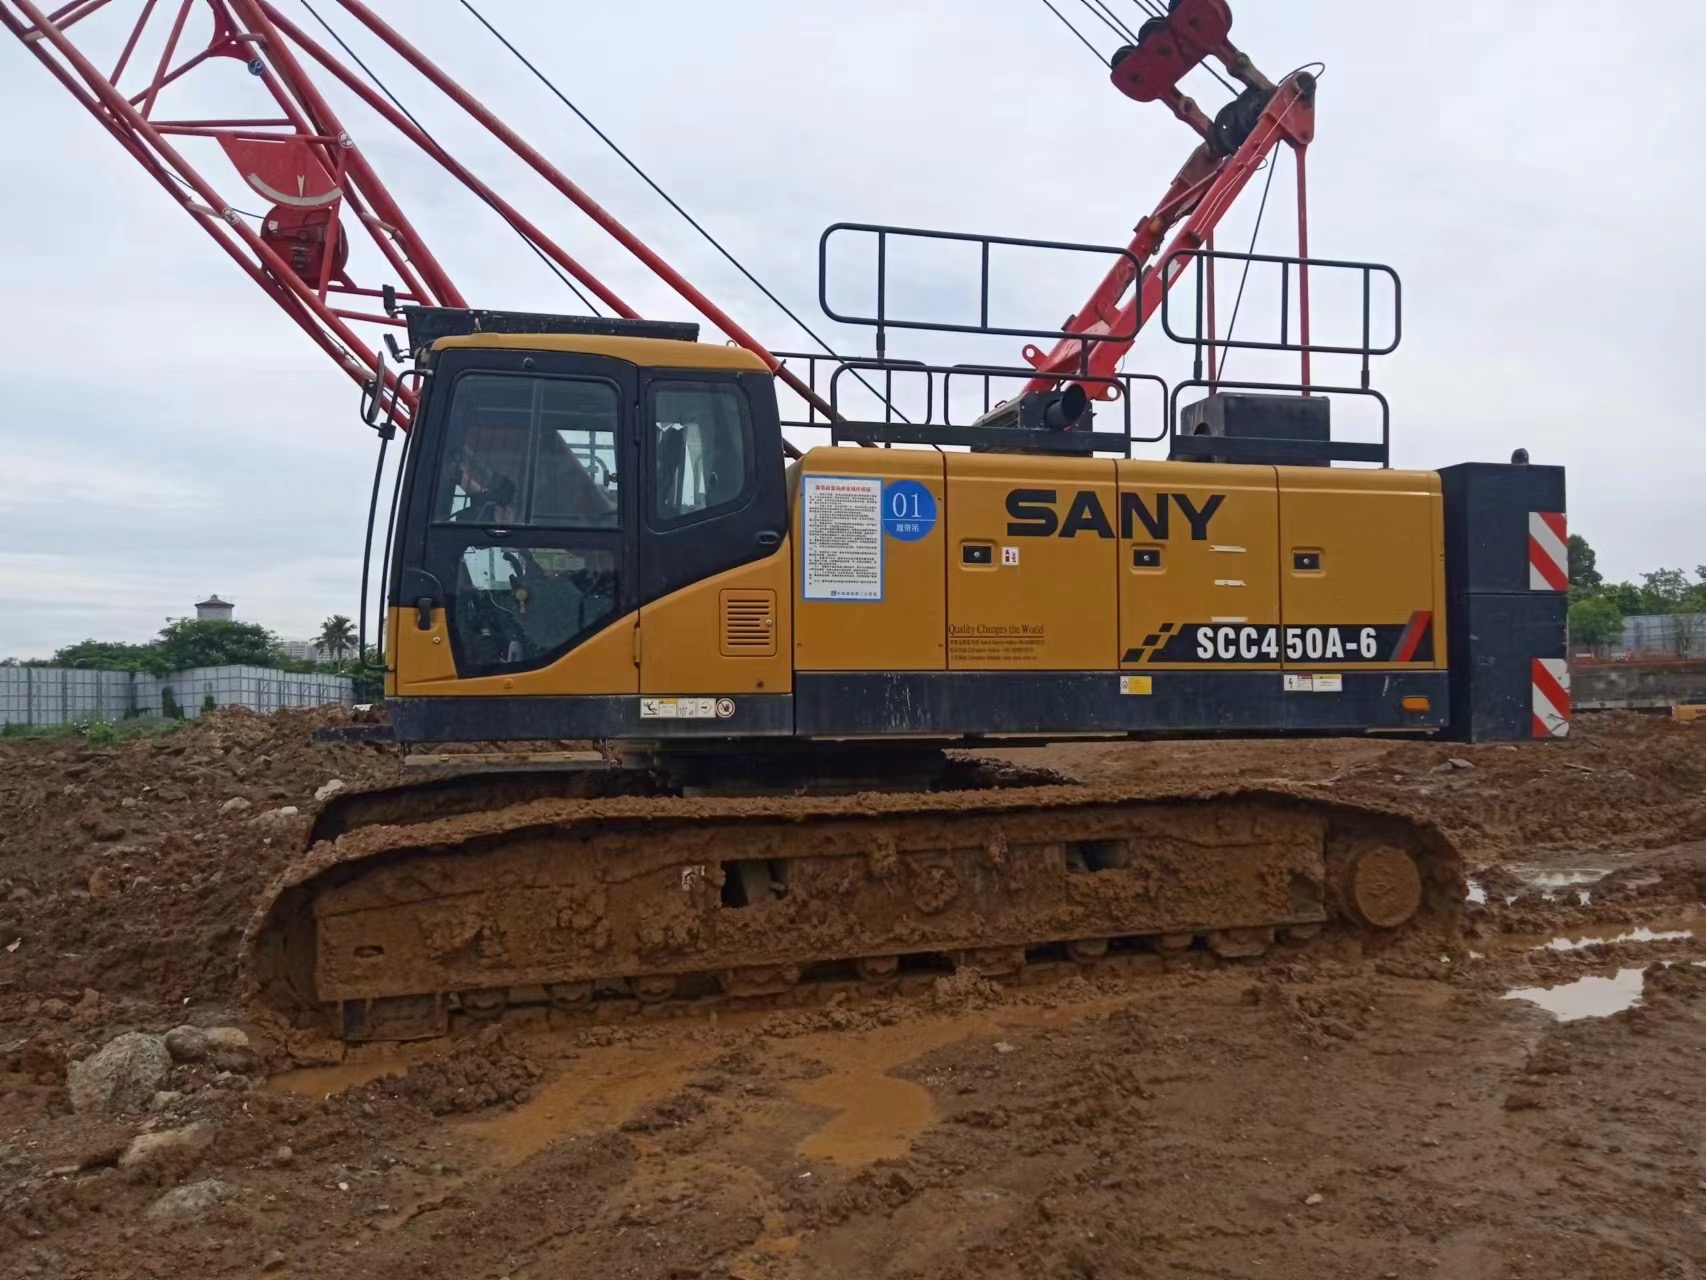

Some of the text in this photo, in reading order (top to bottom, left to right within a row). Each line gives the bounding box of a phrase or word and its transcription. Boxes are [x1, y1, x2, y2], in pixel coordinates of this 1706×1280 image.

[892, 492, 921, 518] 01
[1005, 488, 1226, 540] SANY
[896, 523, 919, 533] 履带吊
[948, 624, 1044, 635] Quality Changes the World
[1196, 626, 1377, 659] SCC450A-6
